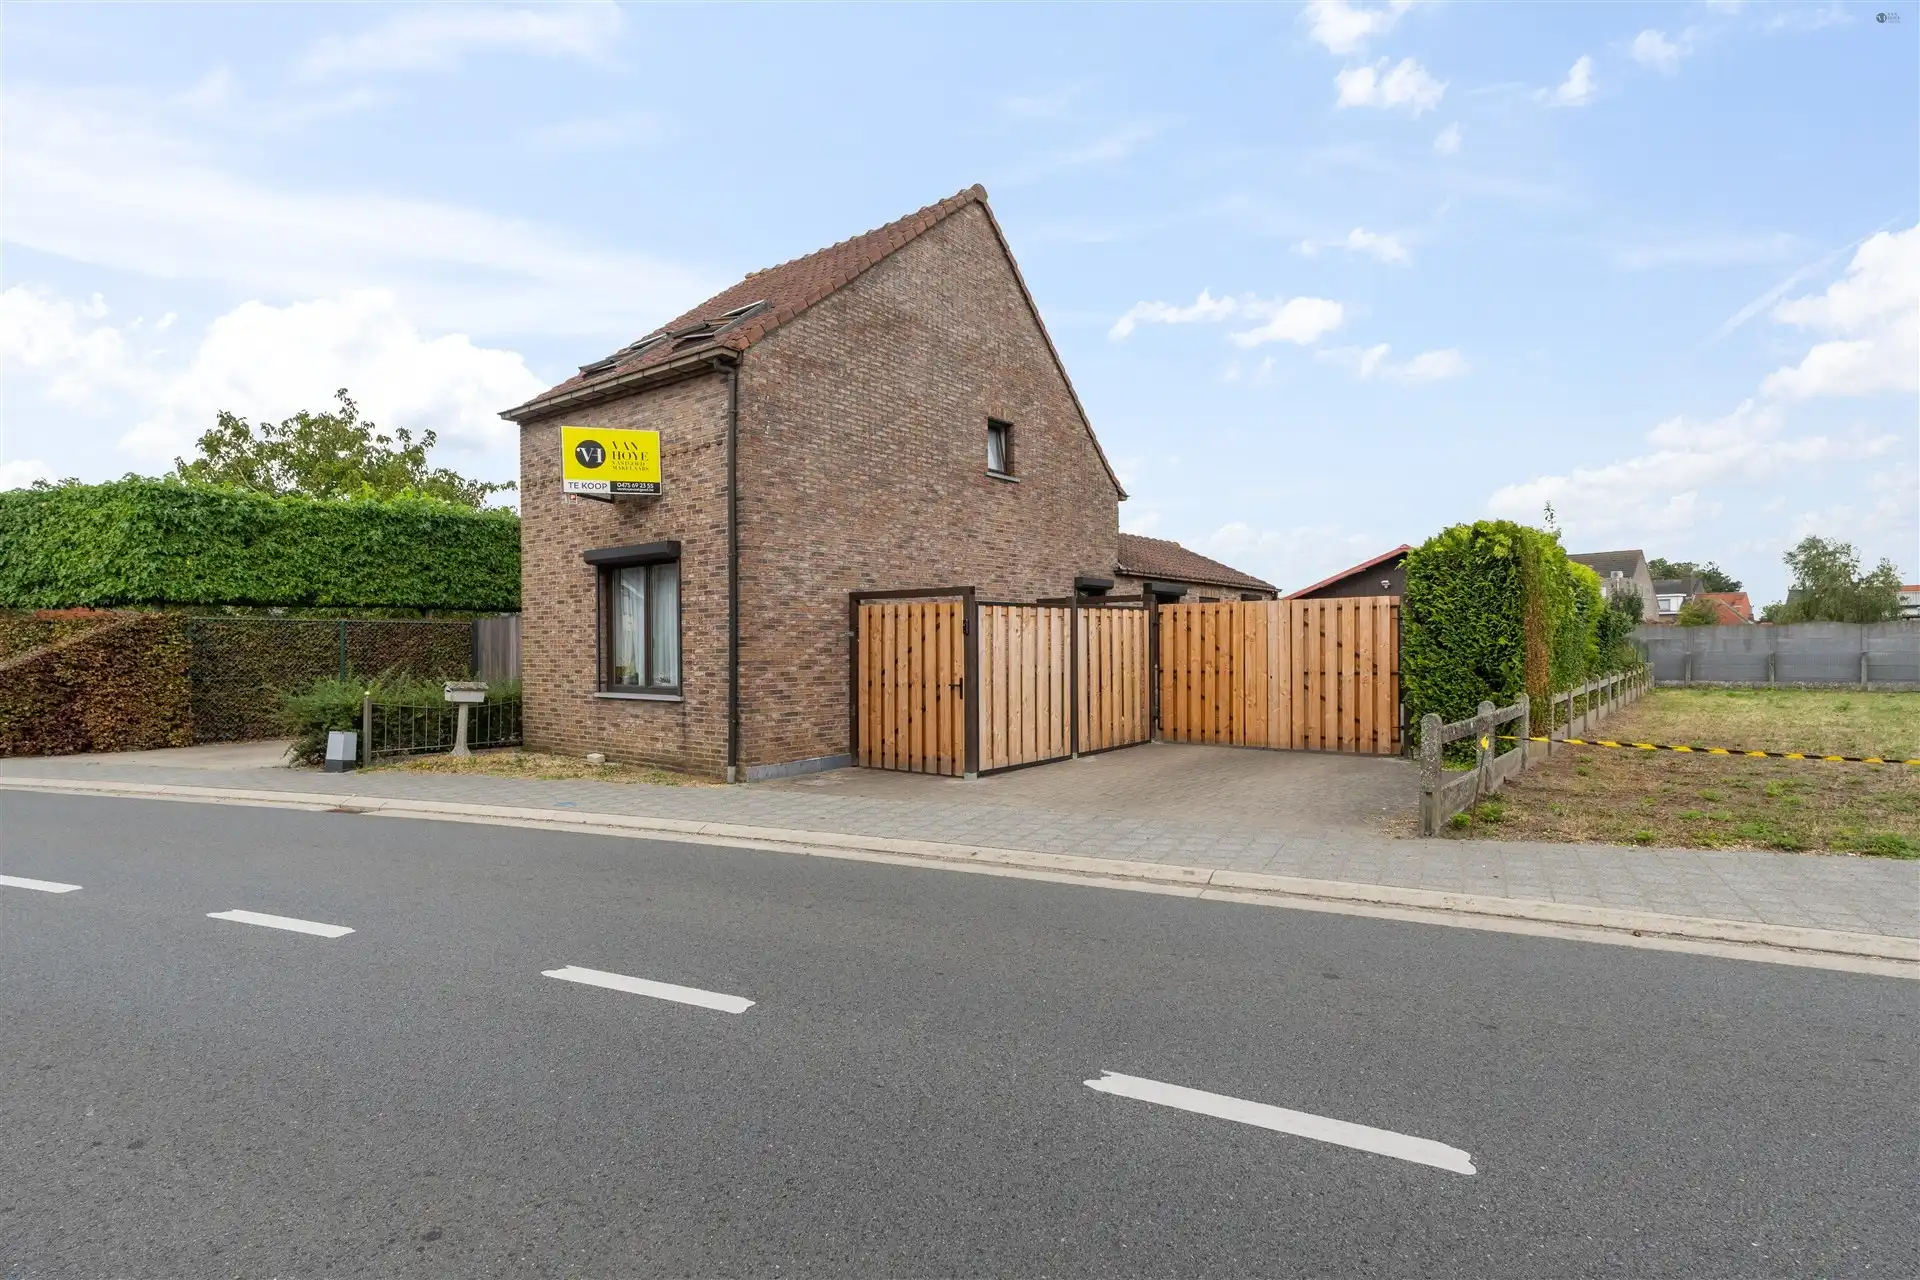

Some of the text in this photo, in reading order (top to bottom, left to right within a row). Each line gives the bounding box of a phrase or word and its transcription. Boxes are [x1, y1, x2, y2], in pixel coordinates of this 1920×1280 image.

[612, 441, 638, 450] VAN
[612, 450, 649, 461] HOYE
[568, 481, 608, 490] TE KOOP
